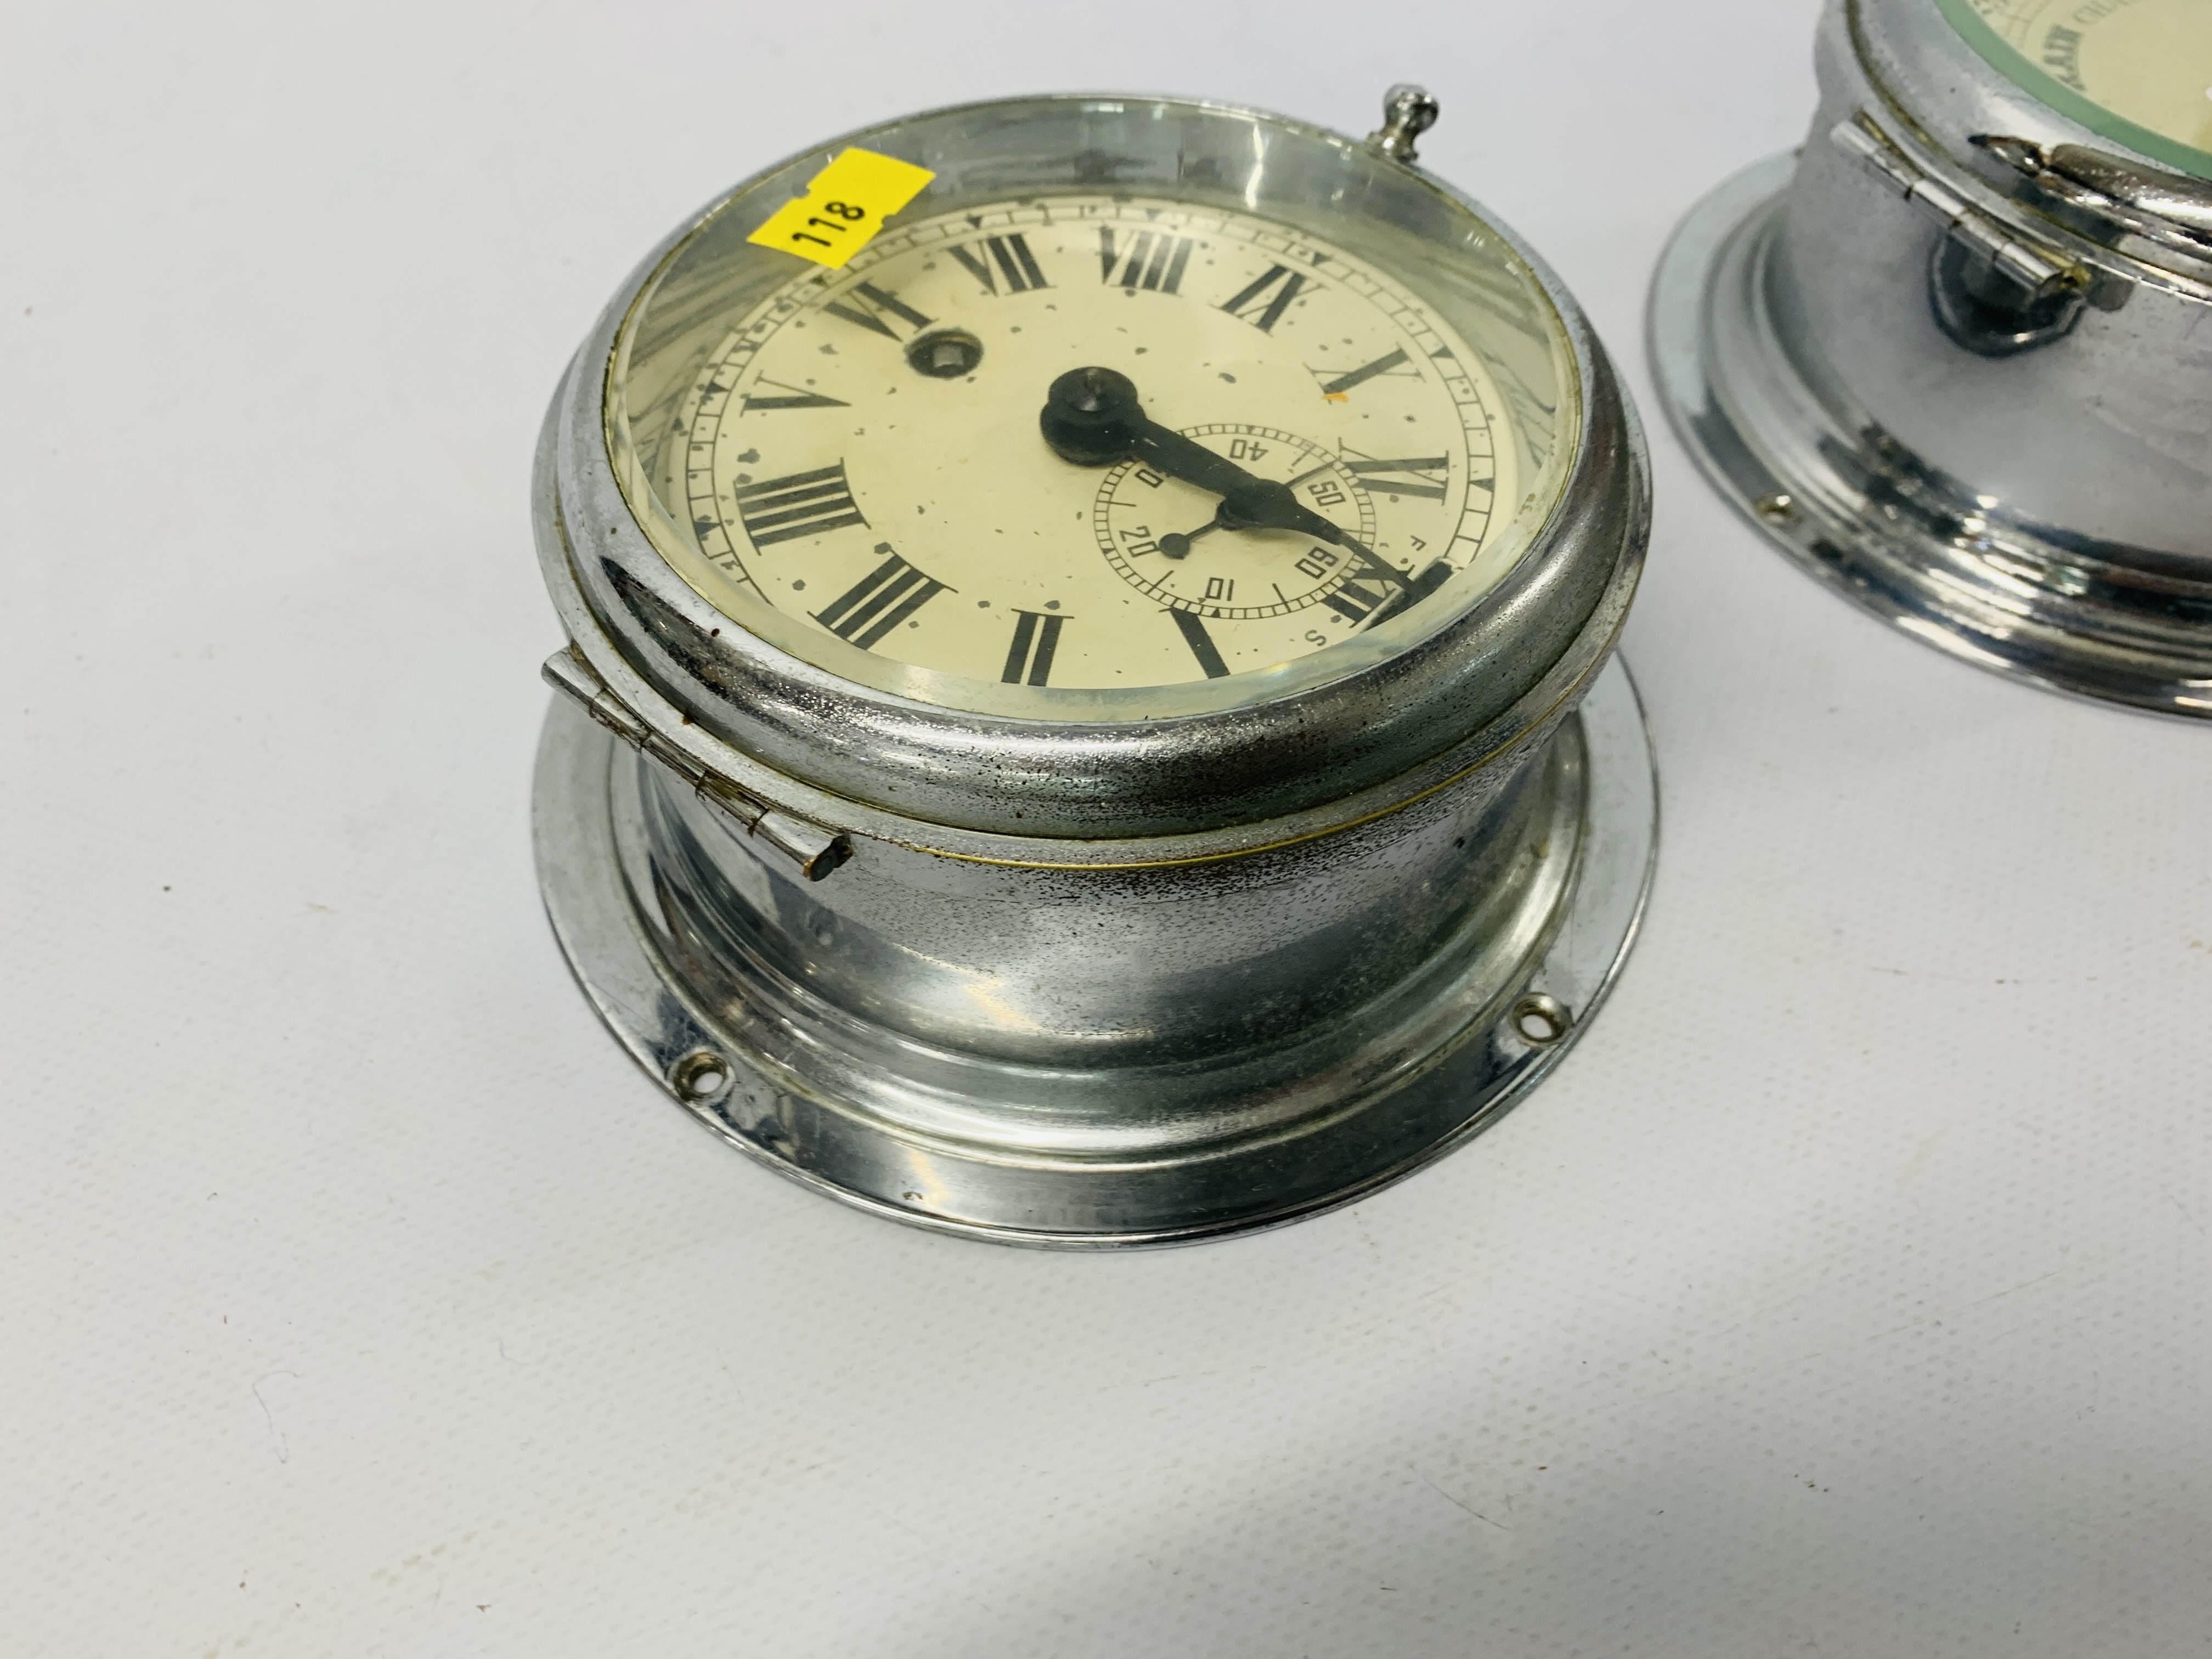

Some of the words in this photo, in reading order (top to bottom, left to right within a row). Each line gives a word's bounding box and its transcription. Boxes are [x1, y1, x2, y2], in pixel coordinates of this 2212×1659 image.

[792, 201, 866, 249] 118
[945, 233, 1057, 298] VII
[1098, 224, 1194, 298] VIII
[816, 276, 940, 345] VI
[1208, 263, 1331, 337] IX
[740, 370, 852, 418] V
[1304, 342, 1426, 405] X
[1229, 438, 1269, 462] 40
[1339, 437, 1450, 506] XI
[733, 456, 873, 556] IIII
[1307, 480, 1346, 509] 50
[1119, 526, 1159, 558] 20
[1295, 546, 1339, 579] 60
[1410, 535, 1427, 551] F
[807, 548, 959, 651] III
[1206, 577, 1235, 601] 10
[1319, 563, 1416, 629] XII
[1001, 608, 1075, 687] II
[1304, 629, 1327, 647] S
